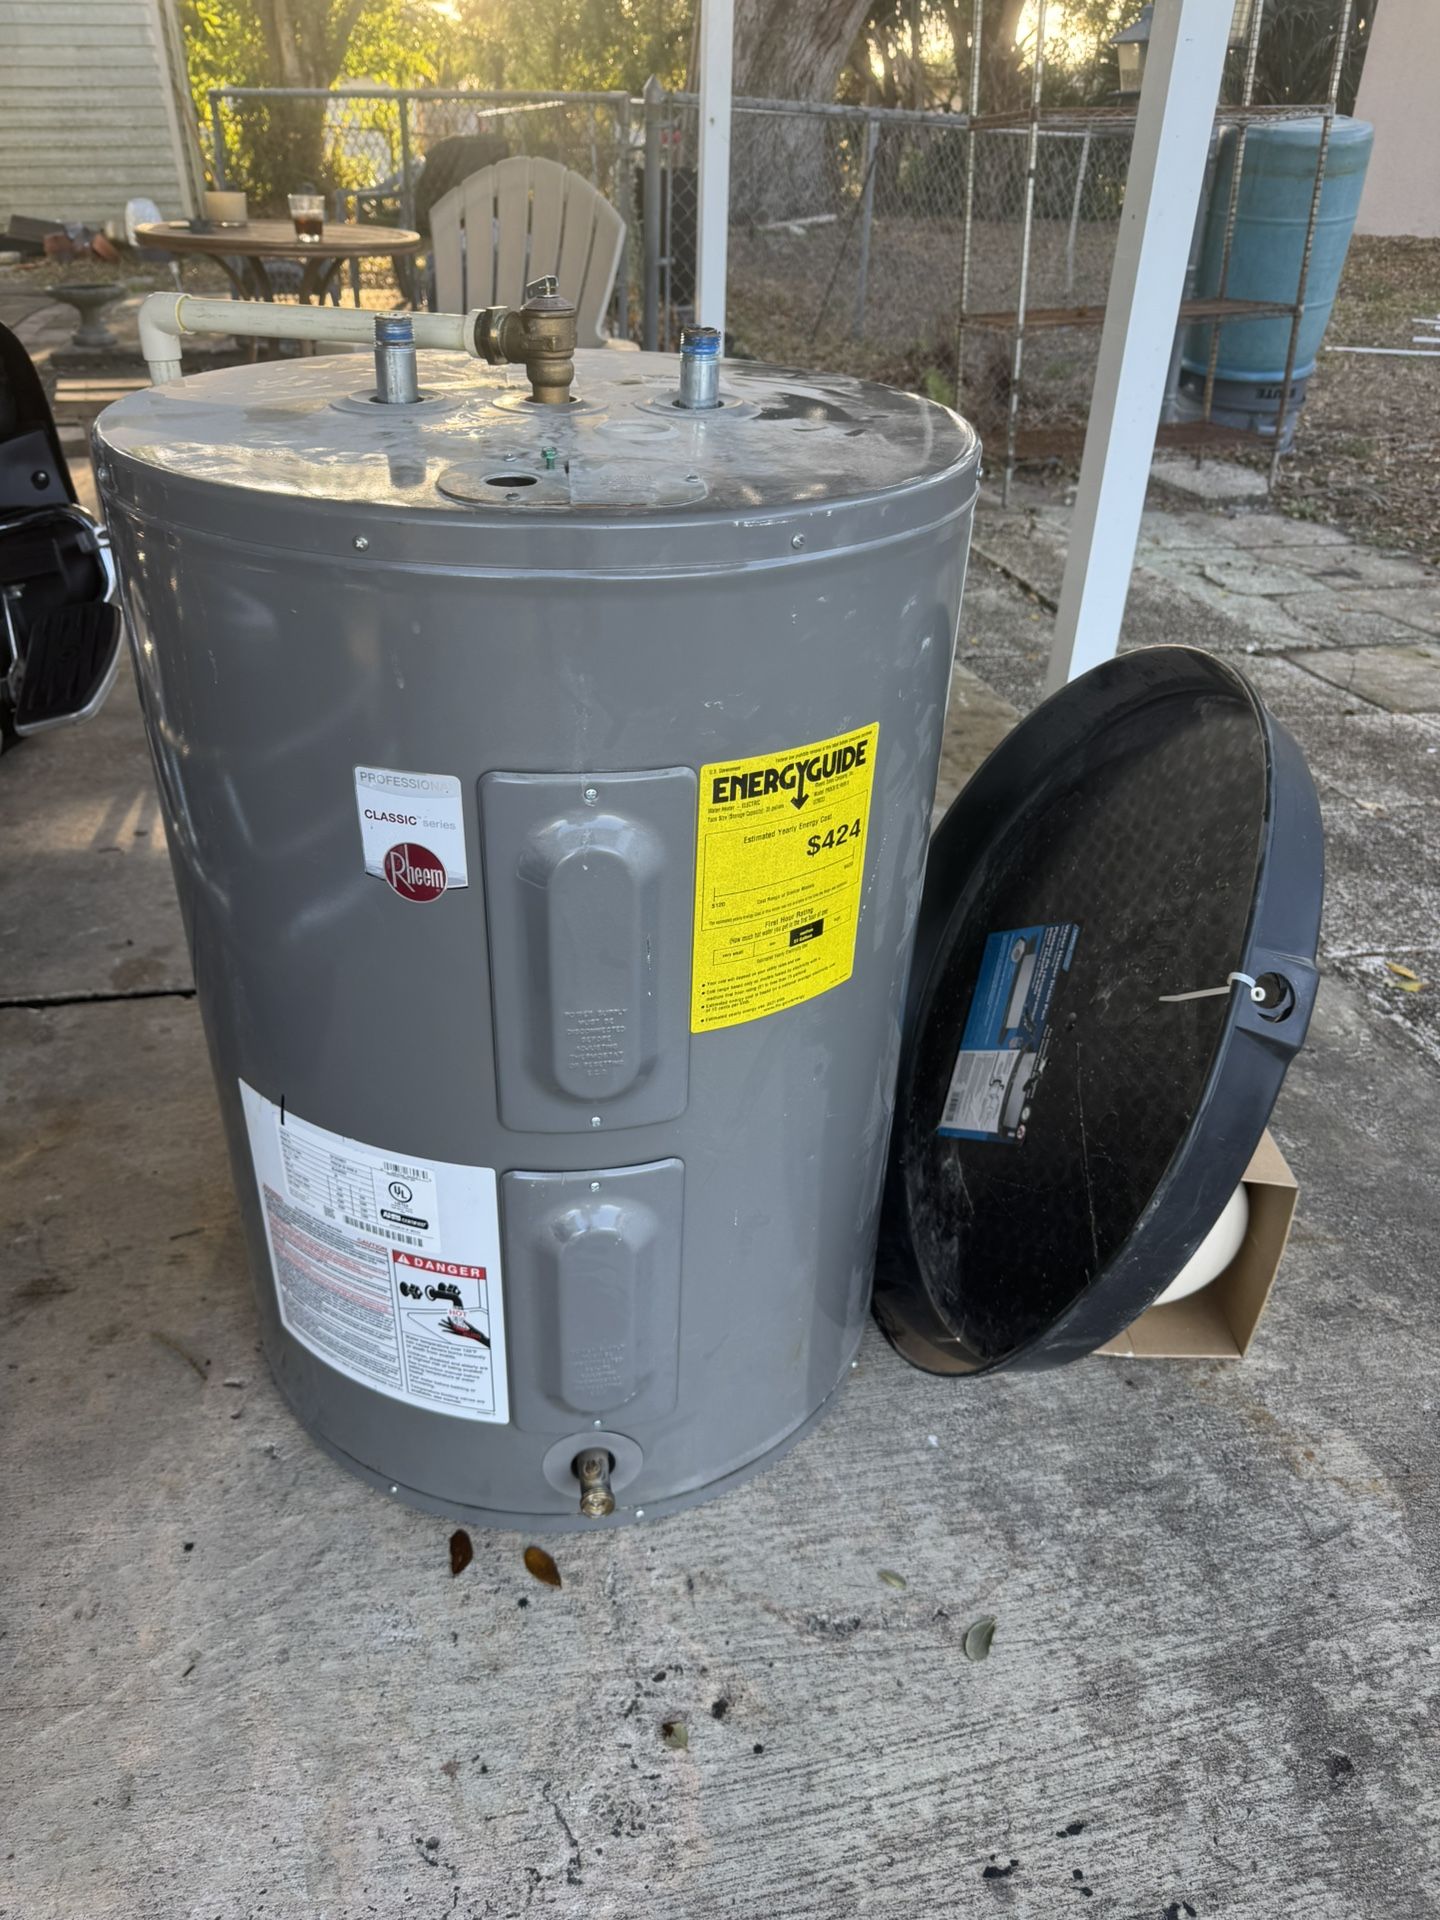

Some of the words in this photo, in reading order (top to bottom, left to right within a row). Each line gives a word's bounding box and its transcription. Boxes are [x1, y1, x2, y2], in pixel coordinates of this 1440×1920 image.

[712, 740, 868, 806] ENERGYGUIDE
[364, 809, 417, 825] CLASSIC
[743, 830, 776, 844] Estimated
[778, 825, 797, 836] Yearly
[799, 819, 819, 830] Energy
[820, 814, 832, 823] Cost
[806, 818, 861, 858] $424
[390, 844, 444, 892] Rheem
[765, 919, 779, 928] First
[780, 914, 795, 923] Hour
[796, 908, 814, 917] Rating
[394, 1185, 408, 1199] UL
[414, 1257, 481, 1278] DANGER
[449, 1309, 467, 1318] HOT
